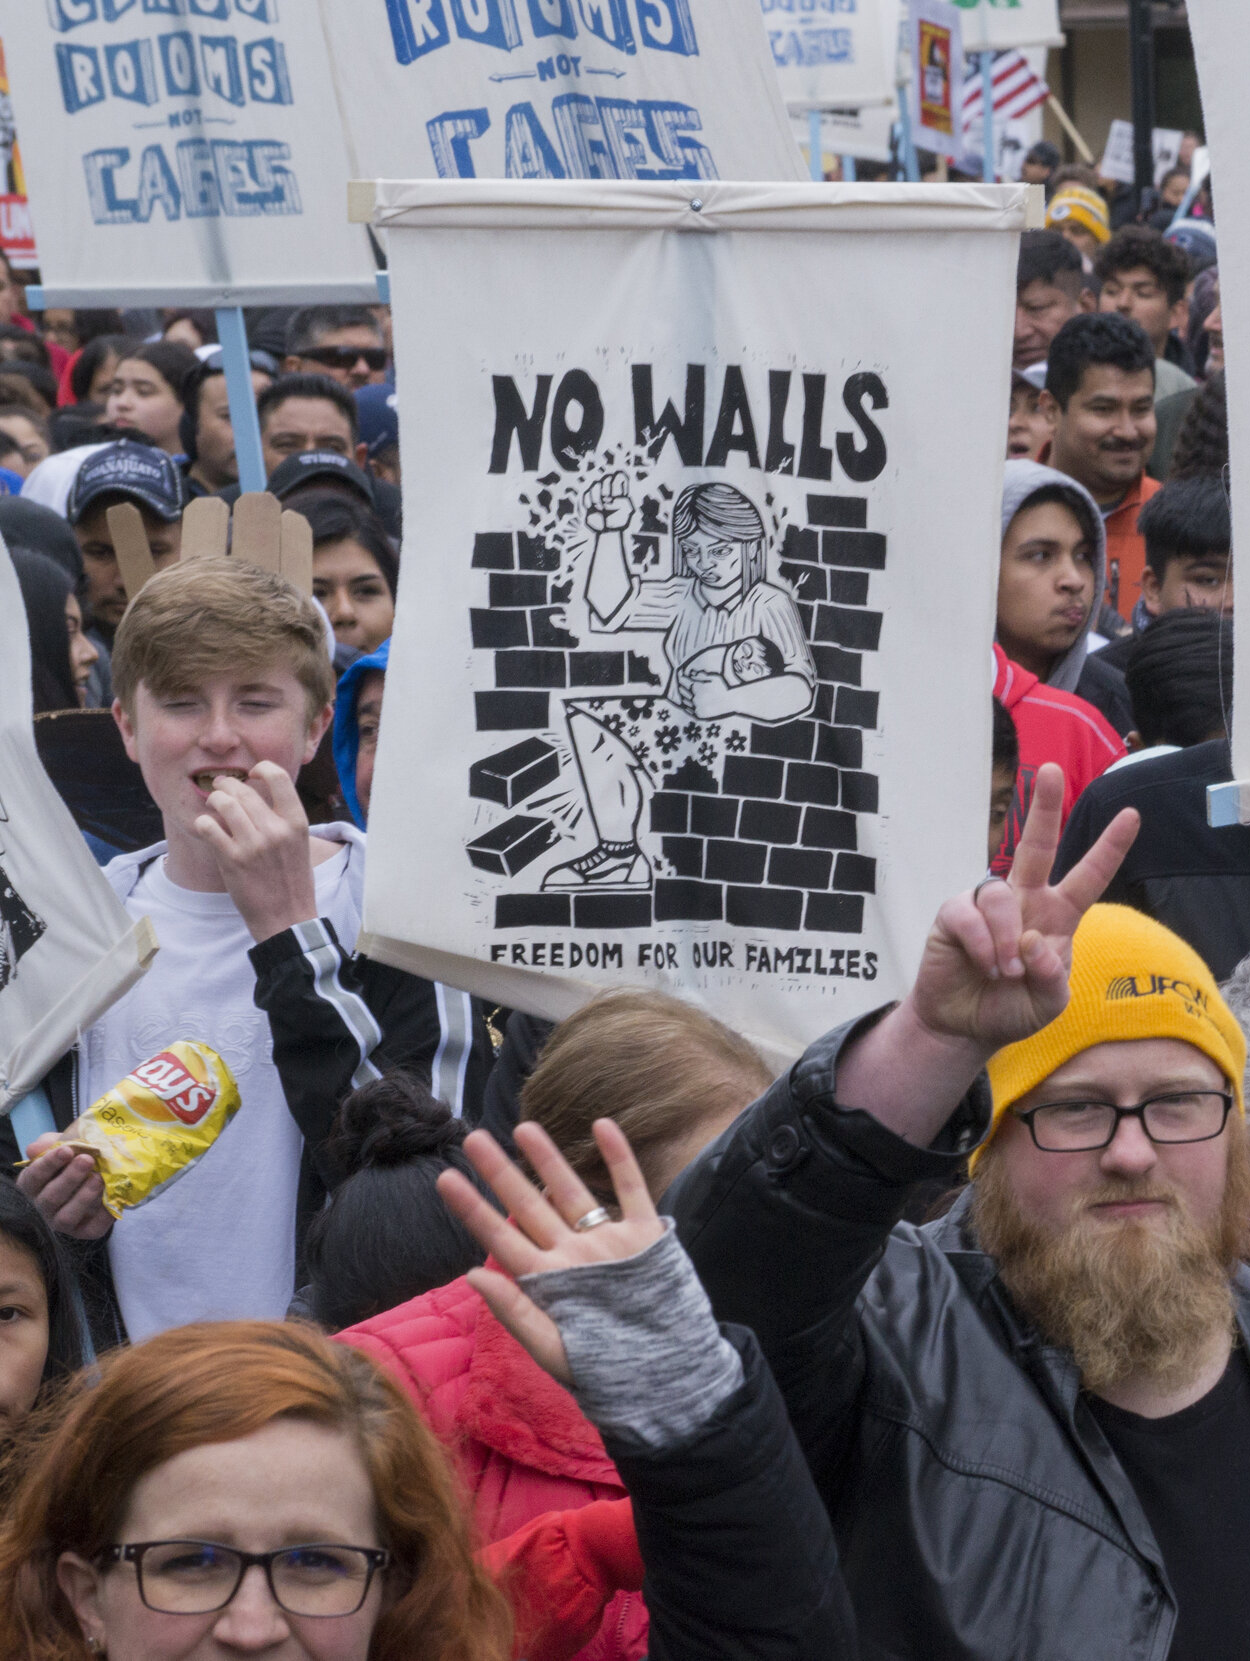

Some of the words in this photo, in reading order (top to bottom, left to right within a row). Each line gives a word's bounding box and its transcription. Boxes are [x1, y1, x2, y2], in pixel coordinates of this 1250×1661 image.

[70, 36, 278, 103] ROOMS
[537, 54, 582, 82] NOT
[168, 109, 202, 128] NOT
[426, 92, 721, 180] CAGES
[82, 137, 303, 225] CAGES
[488, 368, 603, 475] NO
[631, 363, 888, 482] WALLS
[490, 942, 623, 970] FREEDOM
[637, 942, 680, 970] FOR
[693, 940, 736, 969] OUR
[745, 943, 879, 981] FAMILIES
